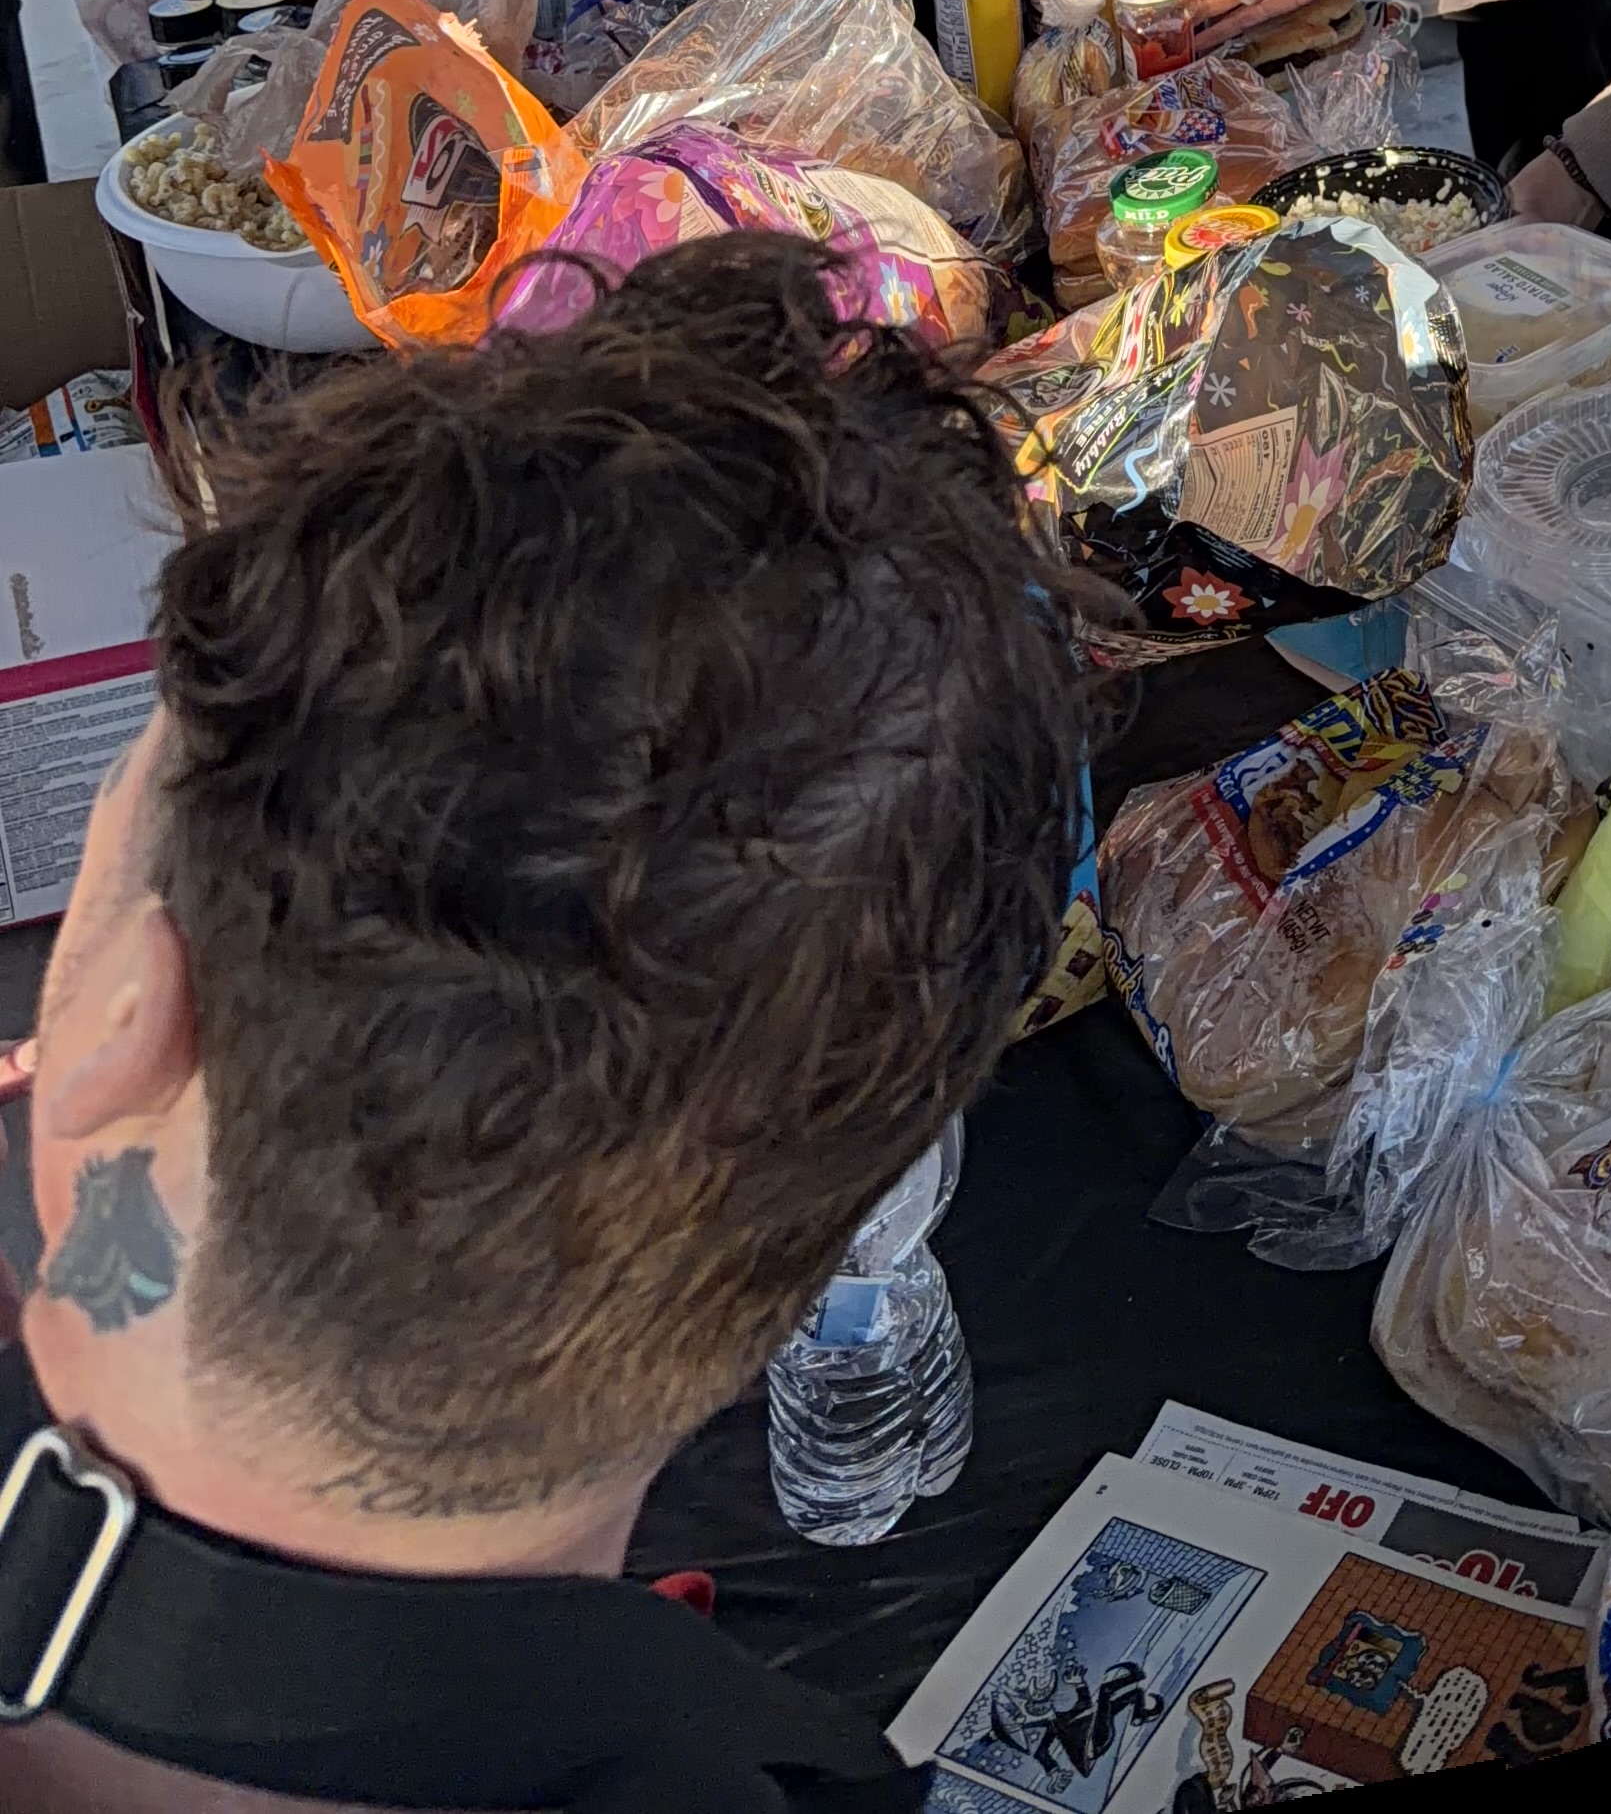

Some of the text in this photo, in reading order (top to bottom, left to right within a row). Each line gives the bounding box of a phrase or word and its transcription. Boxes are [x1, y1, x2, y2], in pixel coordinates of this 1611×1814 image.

[1124, 207, 1169, 221] MILD
[1484, 263, 1518, 283] SALAD
[1515, 280, 1557, 305] POTATO
[1076, 405, 1113, 447] FREE
[1075, 406, 1127, 477] Bubbly
[1297, 899, 1320, 926] NET
[1150, 1454, 1181, 1470] CLOSE
[1191, 1465, 1214, 1483] 10PM
[1224, 1475, 1248, 1495] 3PM
[1253, 1483, 1280, 1502] 12PM
[1299, 1483, 1376, 1529] OFF
